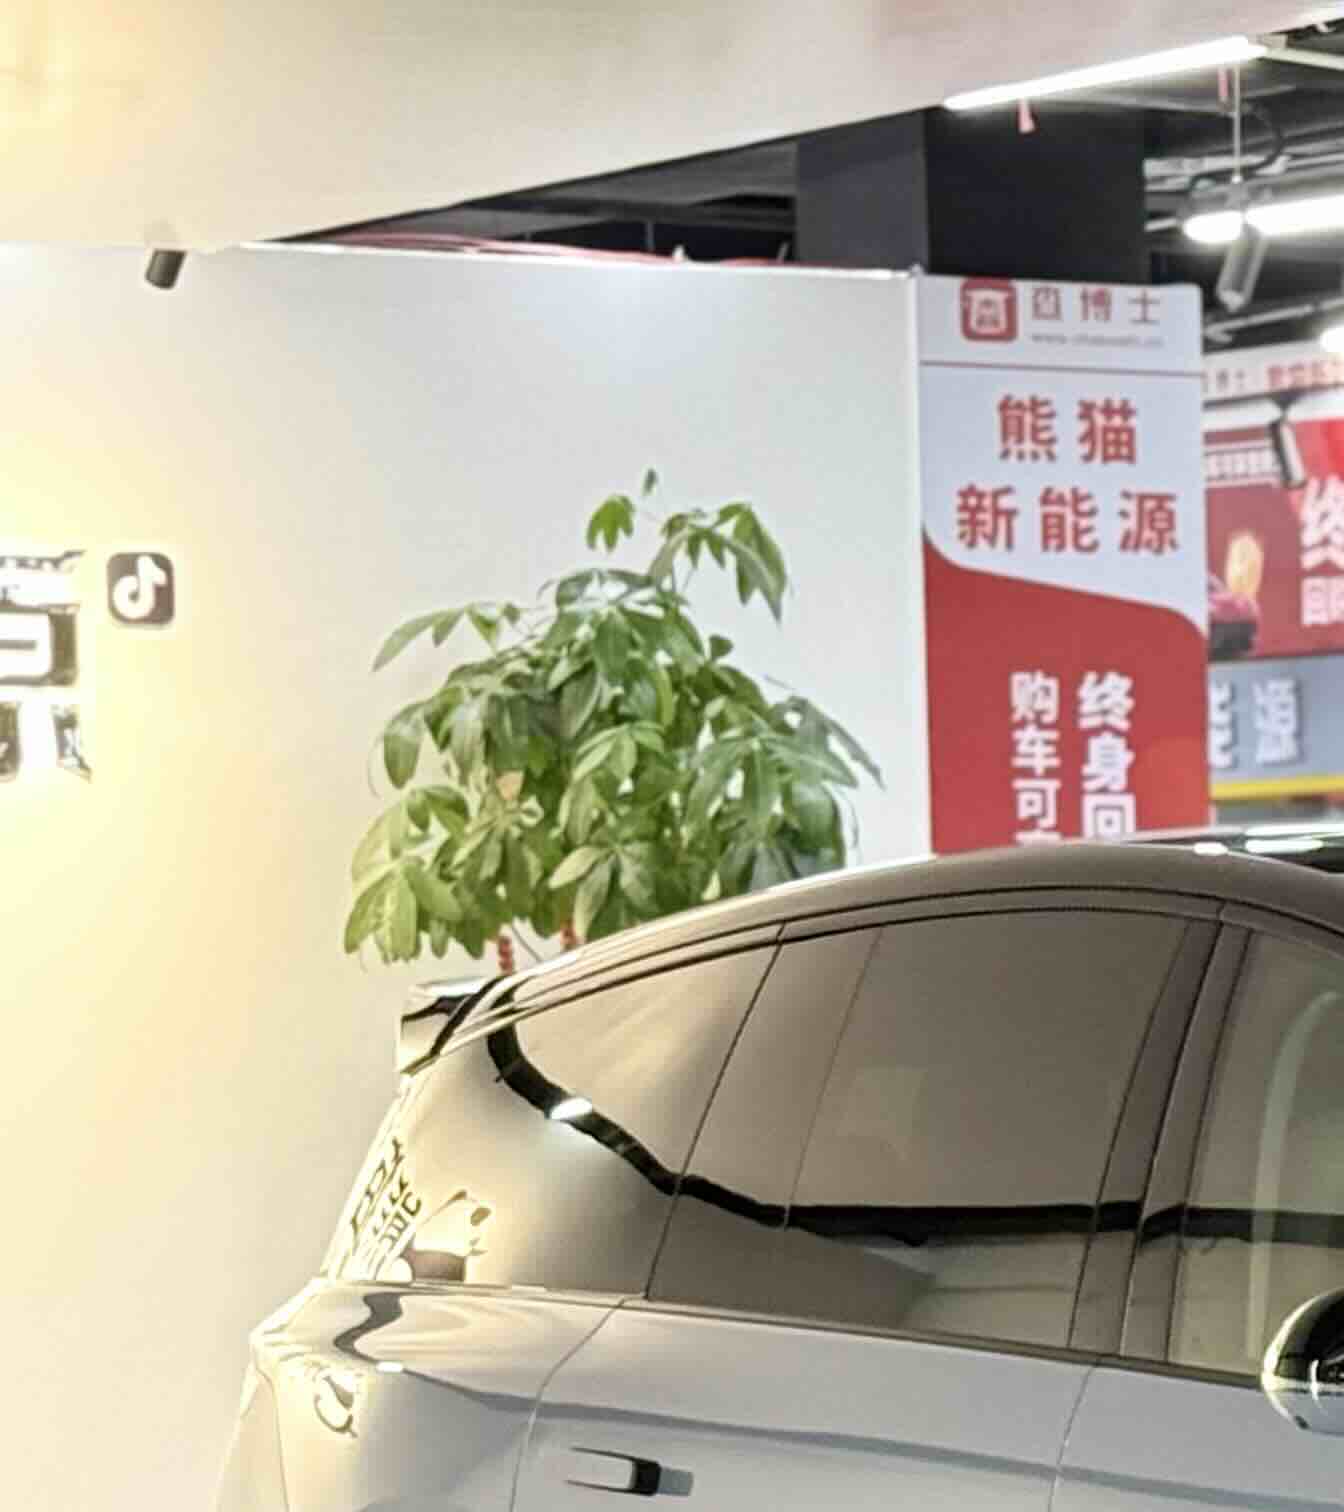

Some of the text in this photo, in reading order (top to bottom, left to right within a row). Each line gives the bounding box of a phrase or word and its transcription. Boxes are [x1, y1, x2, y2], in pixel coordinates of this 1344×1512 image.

[996, 394, 1137, 464] 熊猫
[955, 483, 1179, 555] 新能源
